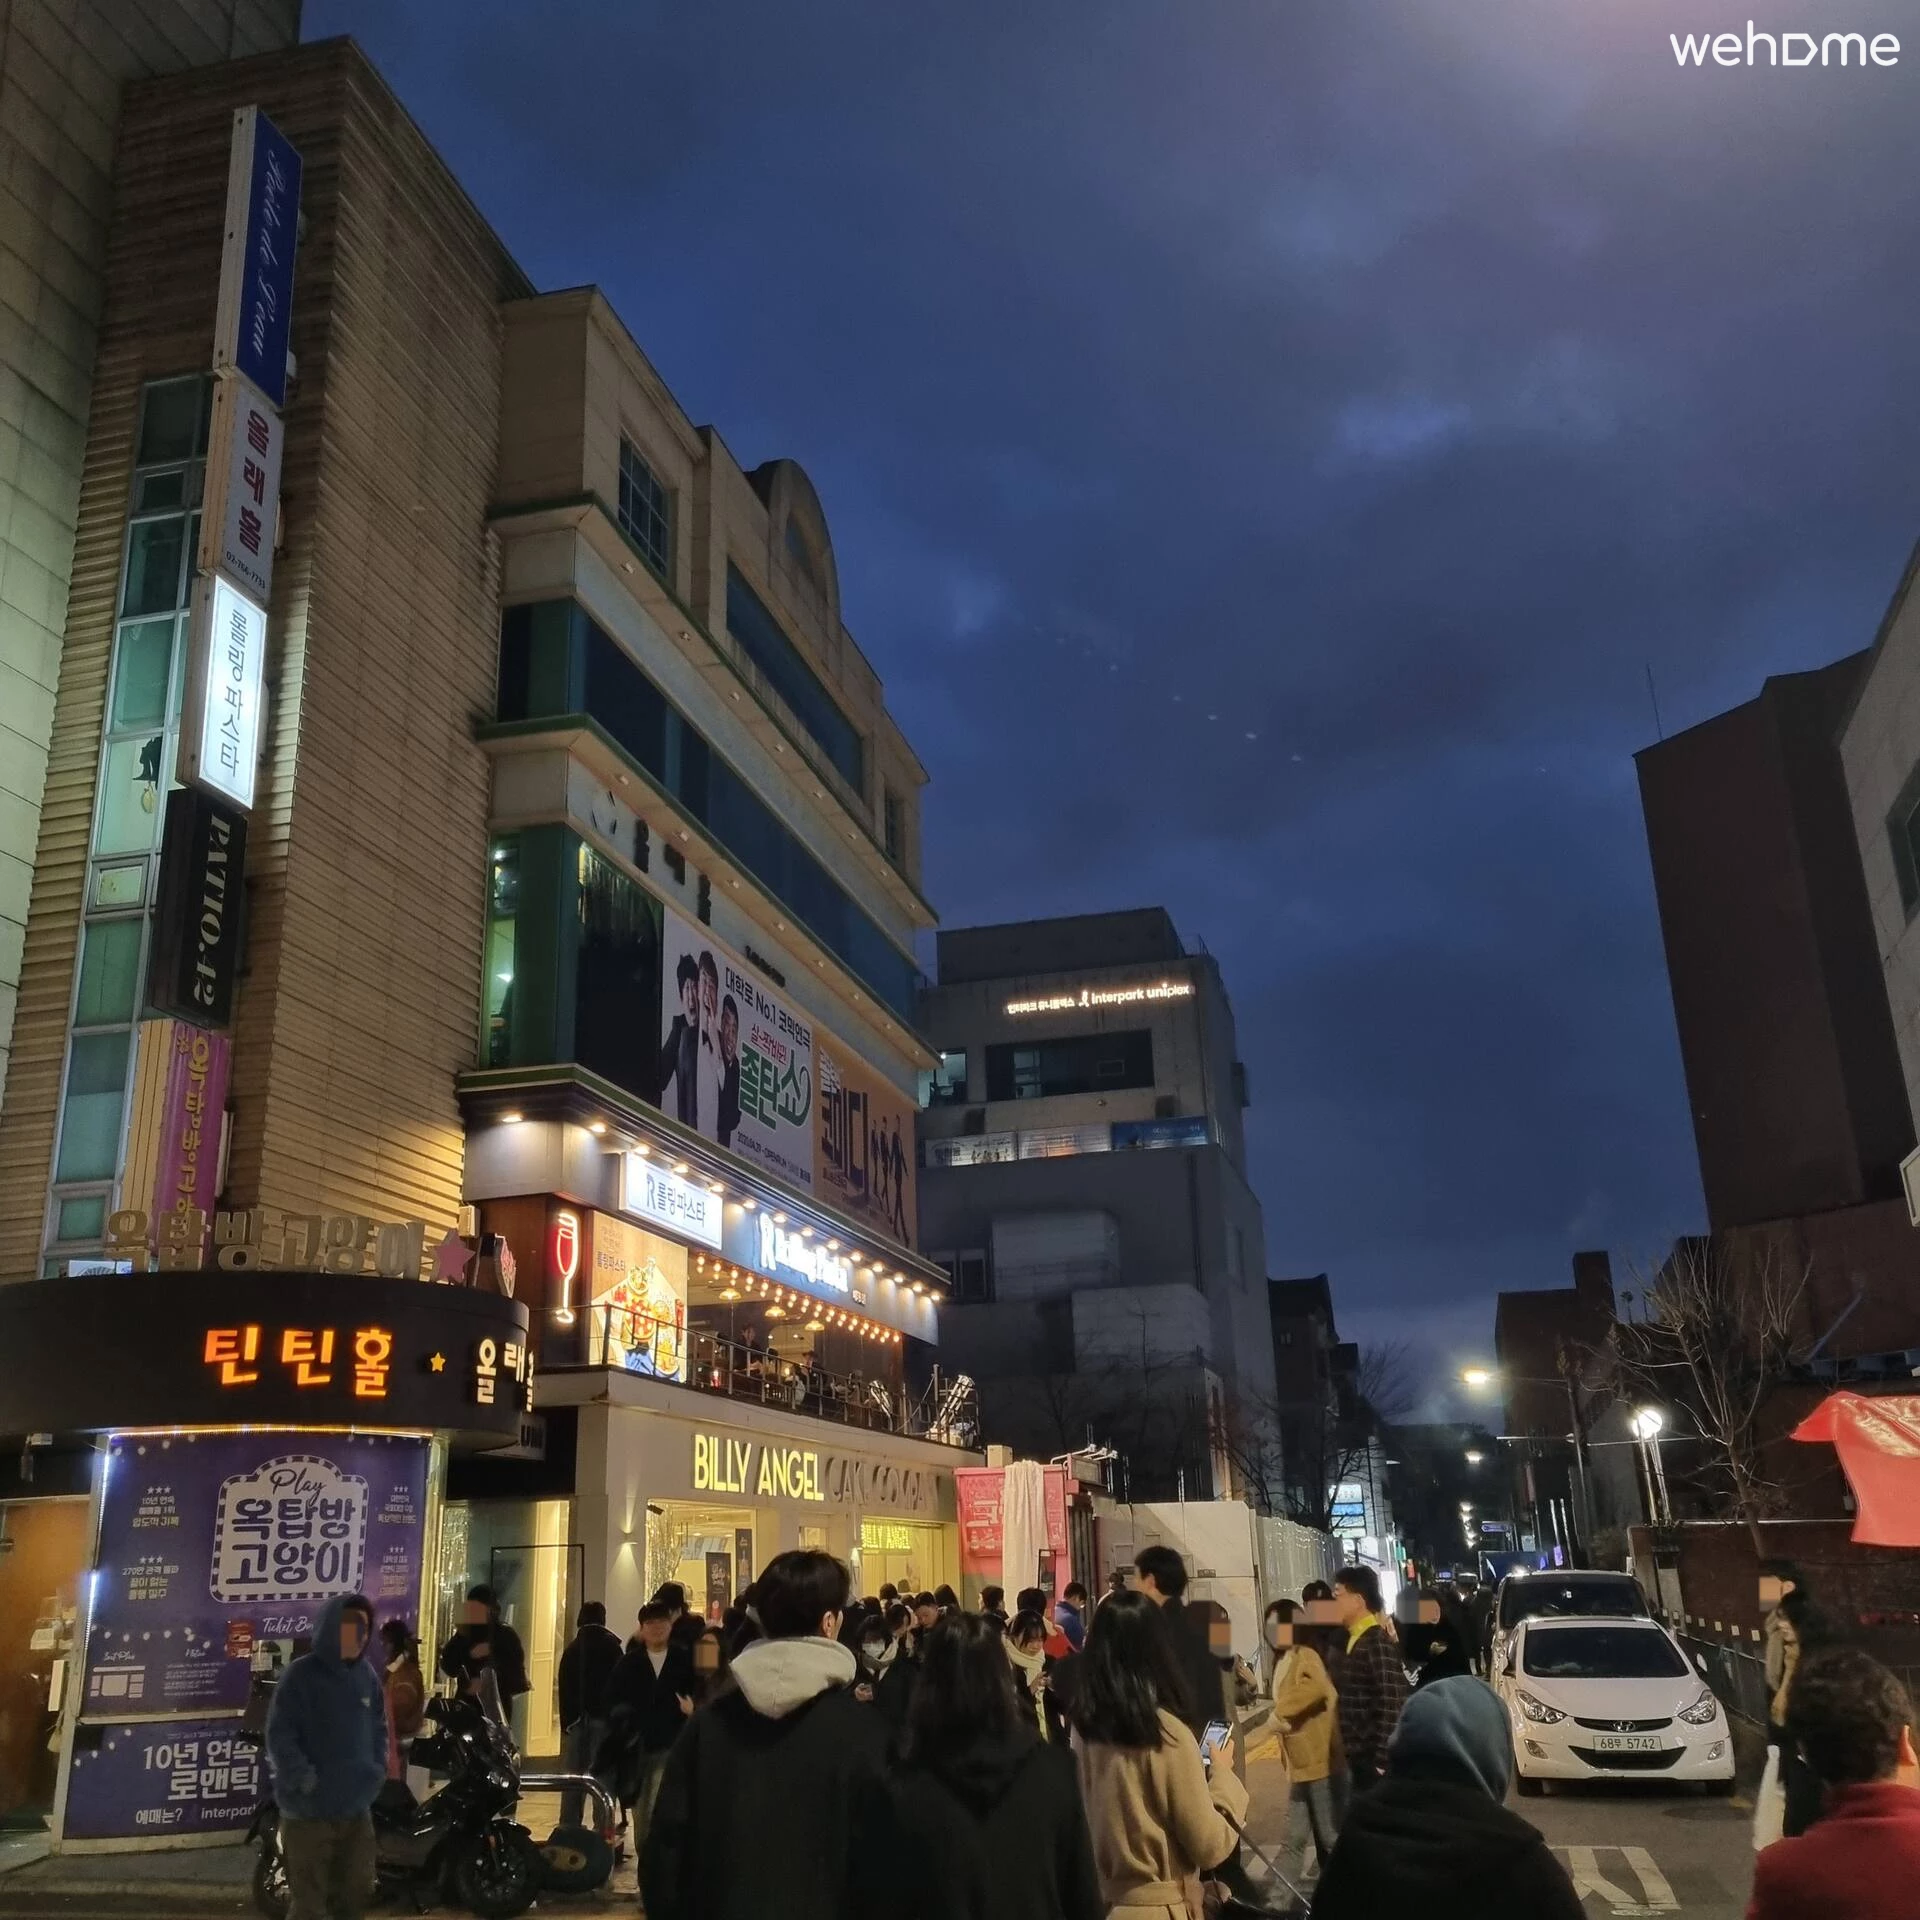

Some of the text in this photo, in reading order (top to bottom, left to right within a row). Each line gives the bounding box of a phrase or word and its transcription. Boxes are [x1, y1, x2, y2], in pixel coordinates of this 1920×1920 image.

[238, 410, 270, 557] 올래홀
[219, 608, 249, 777] 롤링파스타
[193, 811, 232, 1006] PATIO.42
[725, 966, 753, 1007] 대학로
[756, 991, 776, 1025] No.1
[779, 1009, 811, 1052] 코믹연극
[1146, 982, 1190, 999] uniplex
[739, 1042, 812, 1131] 졸탄쇼
[657, 1181, 706, 1228] 롤링파스타
[106, 1209, 426, 1276] 옥탑방고양이
[203, 1326, 393, 1397] 틴틴홀
[269, 1467, 327, 1503] Play
[694, 1434, 752, 1494] BILLY
[756, 1446, 825, 1502] ANGEL
[231, 1497, 356, 1541] 옥탑방
[225, 1541, 351, 1585] 고양이
[262, 1615, 314, 1634] Ticket Bo
[143, 1741, 200, 1771] 10년
[1626, 1738, 1655, 1750] 5742
[167, 1765, 260, 1801] 로맨틱
[135, 1807, 183, 1825] 예매는?
